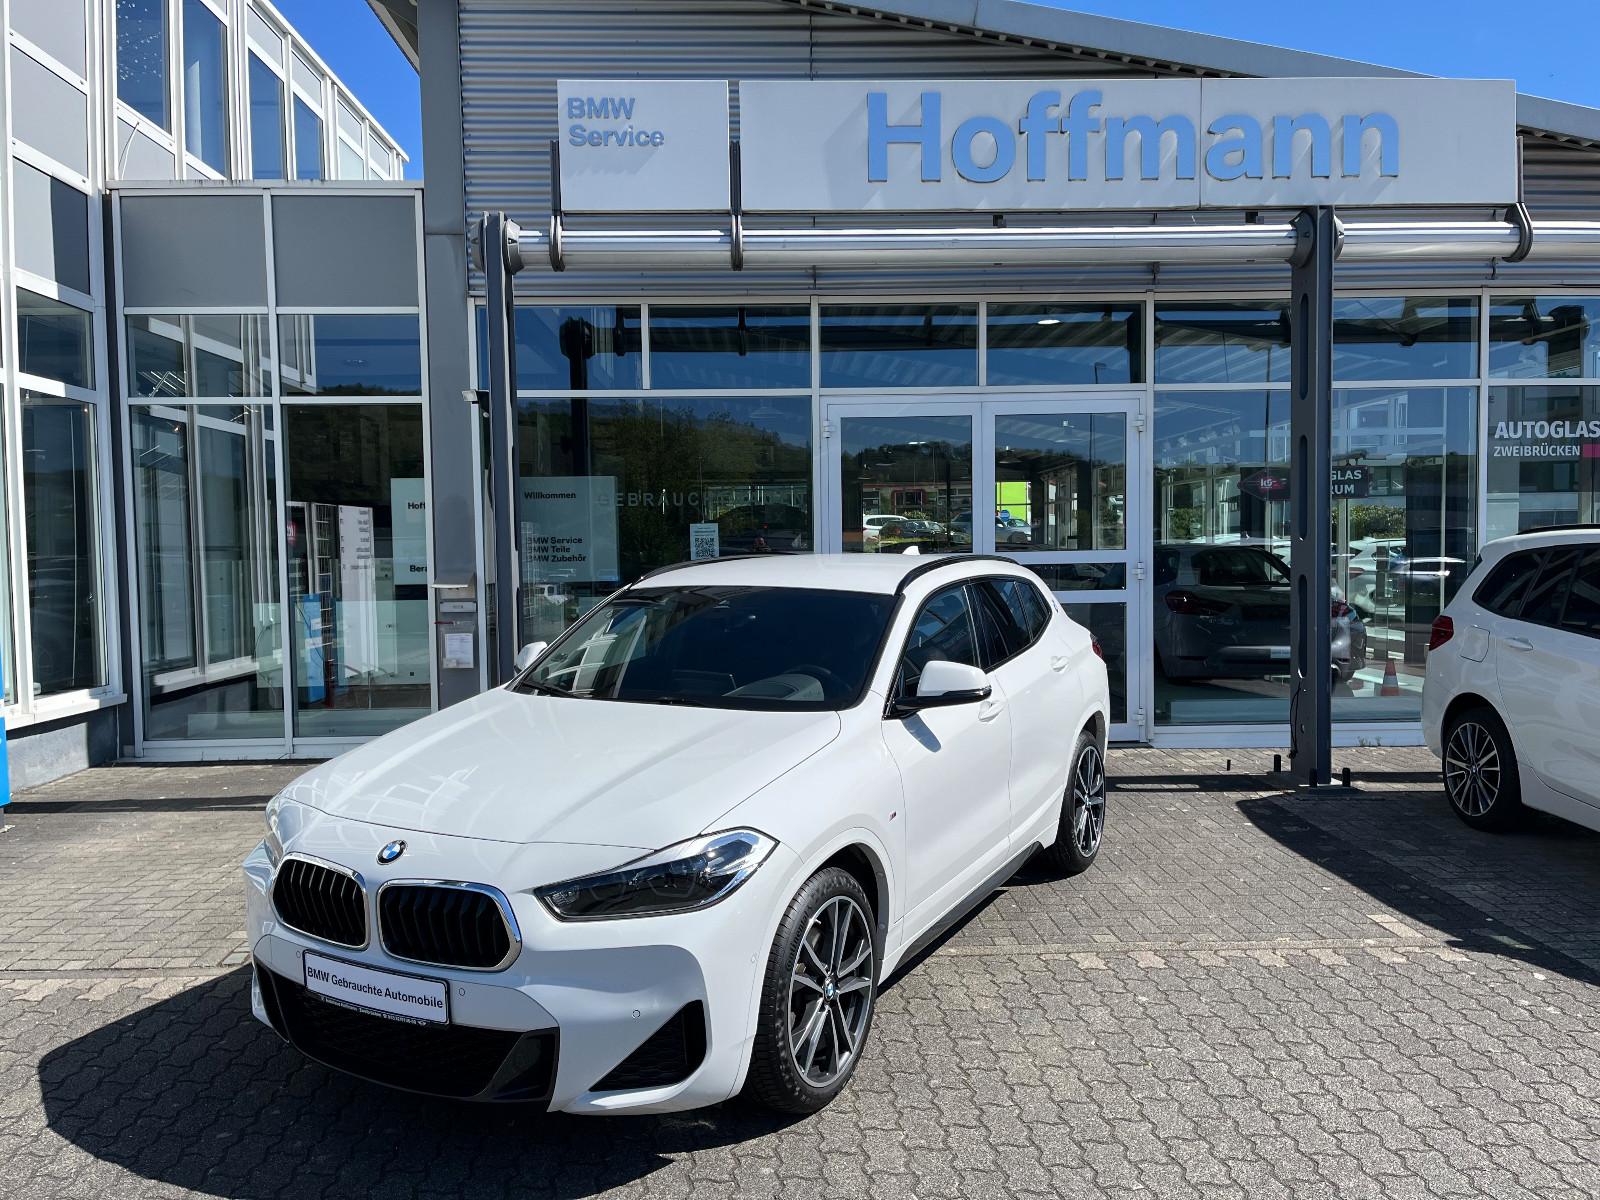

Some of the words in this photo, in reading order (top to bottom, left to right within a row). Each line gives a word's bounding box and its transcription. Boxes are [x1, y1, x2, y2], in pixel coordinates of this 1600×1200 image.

[567, 97, 636, 120] BMW
[568, 124, 664, 147] Service
[867, 90, 1399, 184] Hoffmann
[1494, 420, 1600, 439] AUTOGLAS
[1493, 443, 1580, 457] ZWEIBRÜCKEN
[524, 491, 577, 500] Willkommen
[550, 536, 583, 545] Service
[550, 545, 571, 553] Teile
[551, 553, 587, 562] Zubehör
[307, 966, 330, 983] BMW
[331, 974, 383, 997] Gebrauchte
[384, 988, 444, 1009] Automobile
